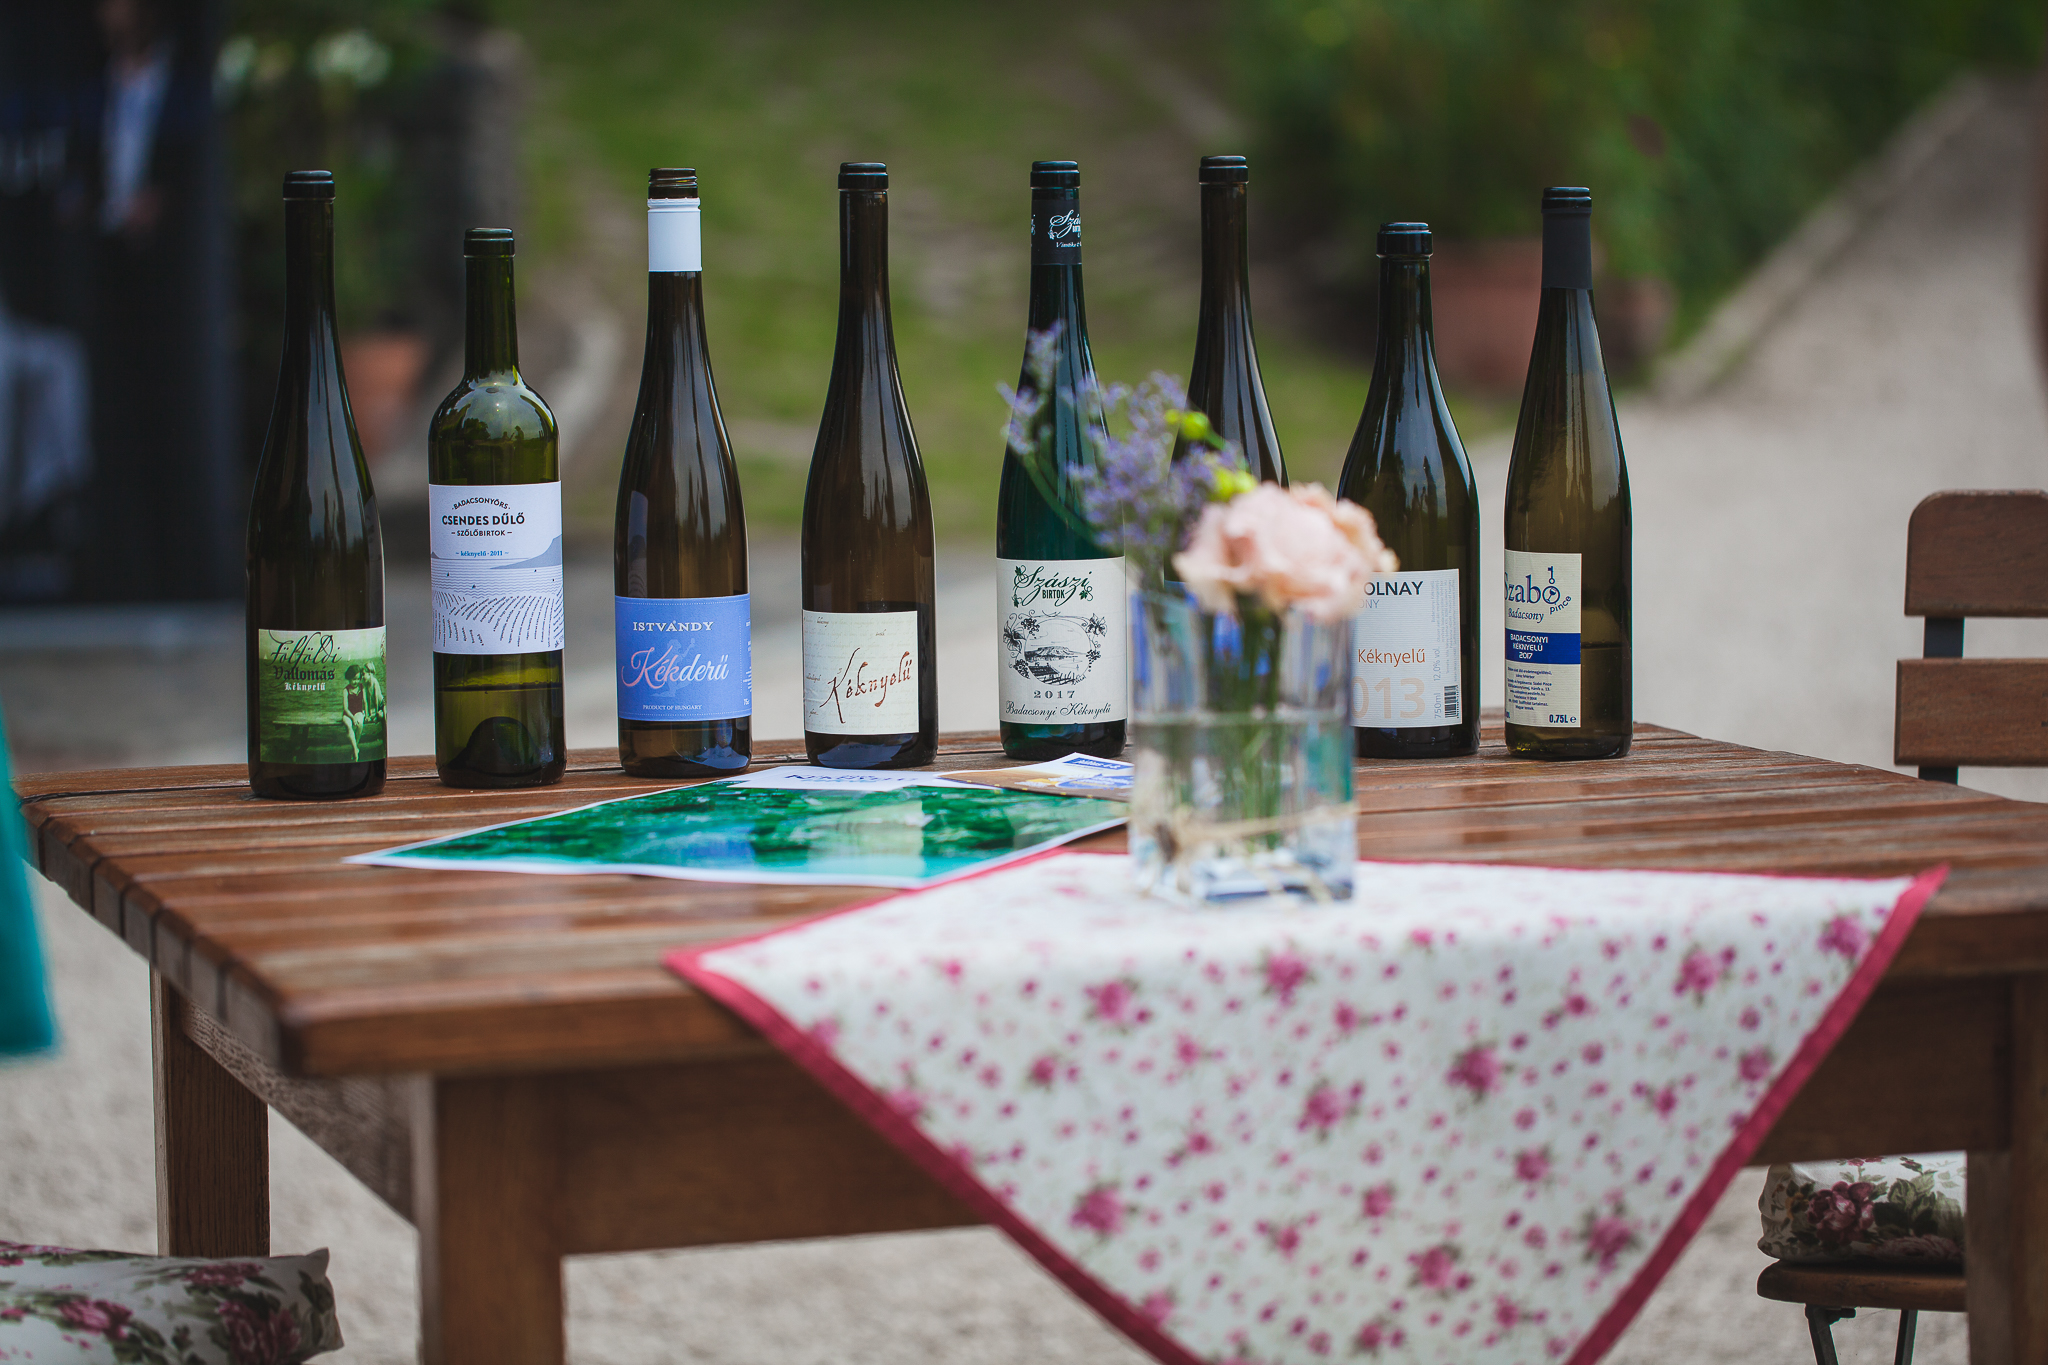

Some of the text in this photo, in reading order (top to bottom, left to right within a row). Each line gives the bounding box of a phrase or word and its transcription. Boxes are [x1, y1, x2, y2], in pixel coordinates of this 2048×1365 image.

[441, 512, 525, 525] CSENDES DŰLŐ
[456, 529, 506, 537] SZŐLŐBIRTOK
[1014, 565, 1093, 607] Szászi
[1042, 589, 1066, 599] BIRTOK
[1508, 607, 1545, 624] Badacsony
[1510, 633, 1549, 644] BADACSONYI
[1358, 648, 1426, 668] Kéknyelű
[1518, 652, 1533, 660] 2017
[274, 666, 336, 680] Vallomás
[819, 647, 913, 724] Kéknyelű
[1033, 690, 1076, 699] 2017
[1005, 700, 1111, 720] Badacsonyi Kéknyelű
[1434, 692, 1442, 719] 750ml
